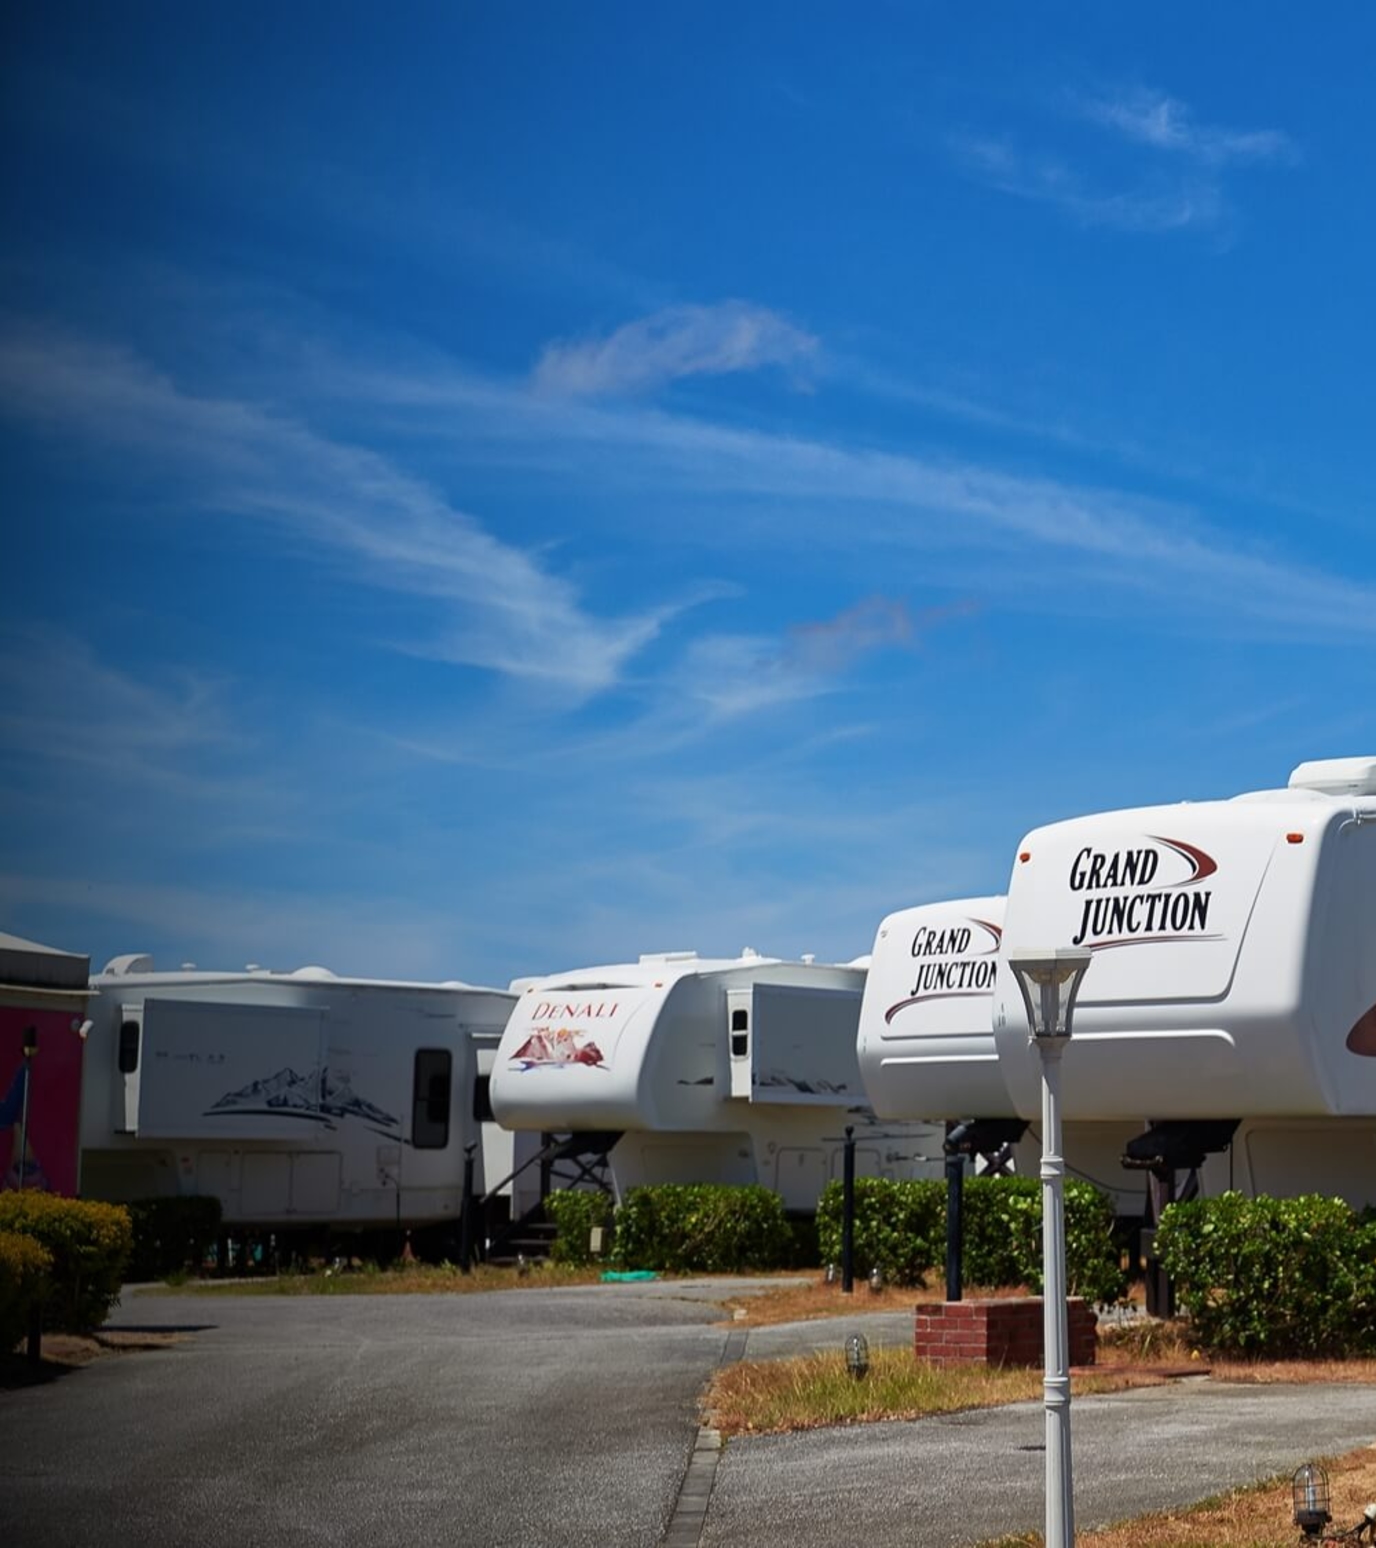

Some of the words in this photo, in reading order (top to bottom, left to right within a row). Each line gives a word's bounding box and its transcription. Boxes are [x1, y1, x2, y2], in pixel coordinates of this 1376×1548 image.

[1069, 847, 1159, 891] GRAND
[1072, 891, 1212, 945] JUNCTION
[911, 926, 971, 957] GRAND
[532, 1002, 619, 1020] DENALI
